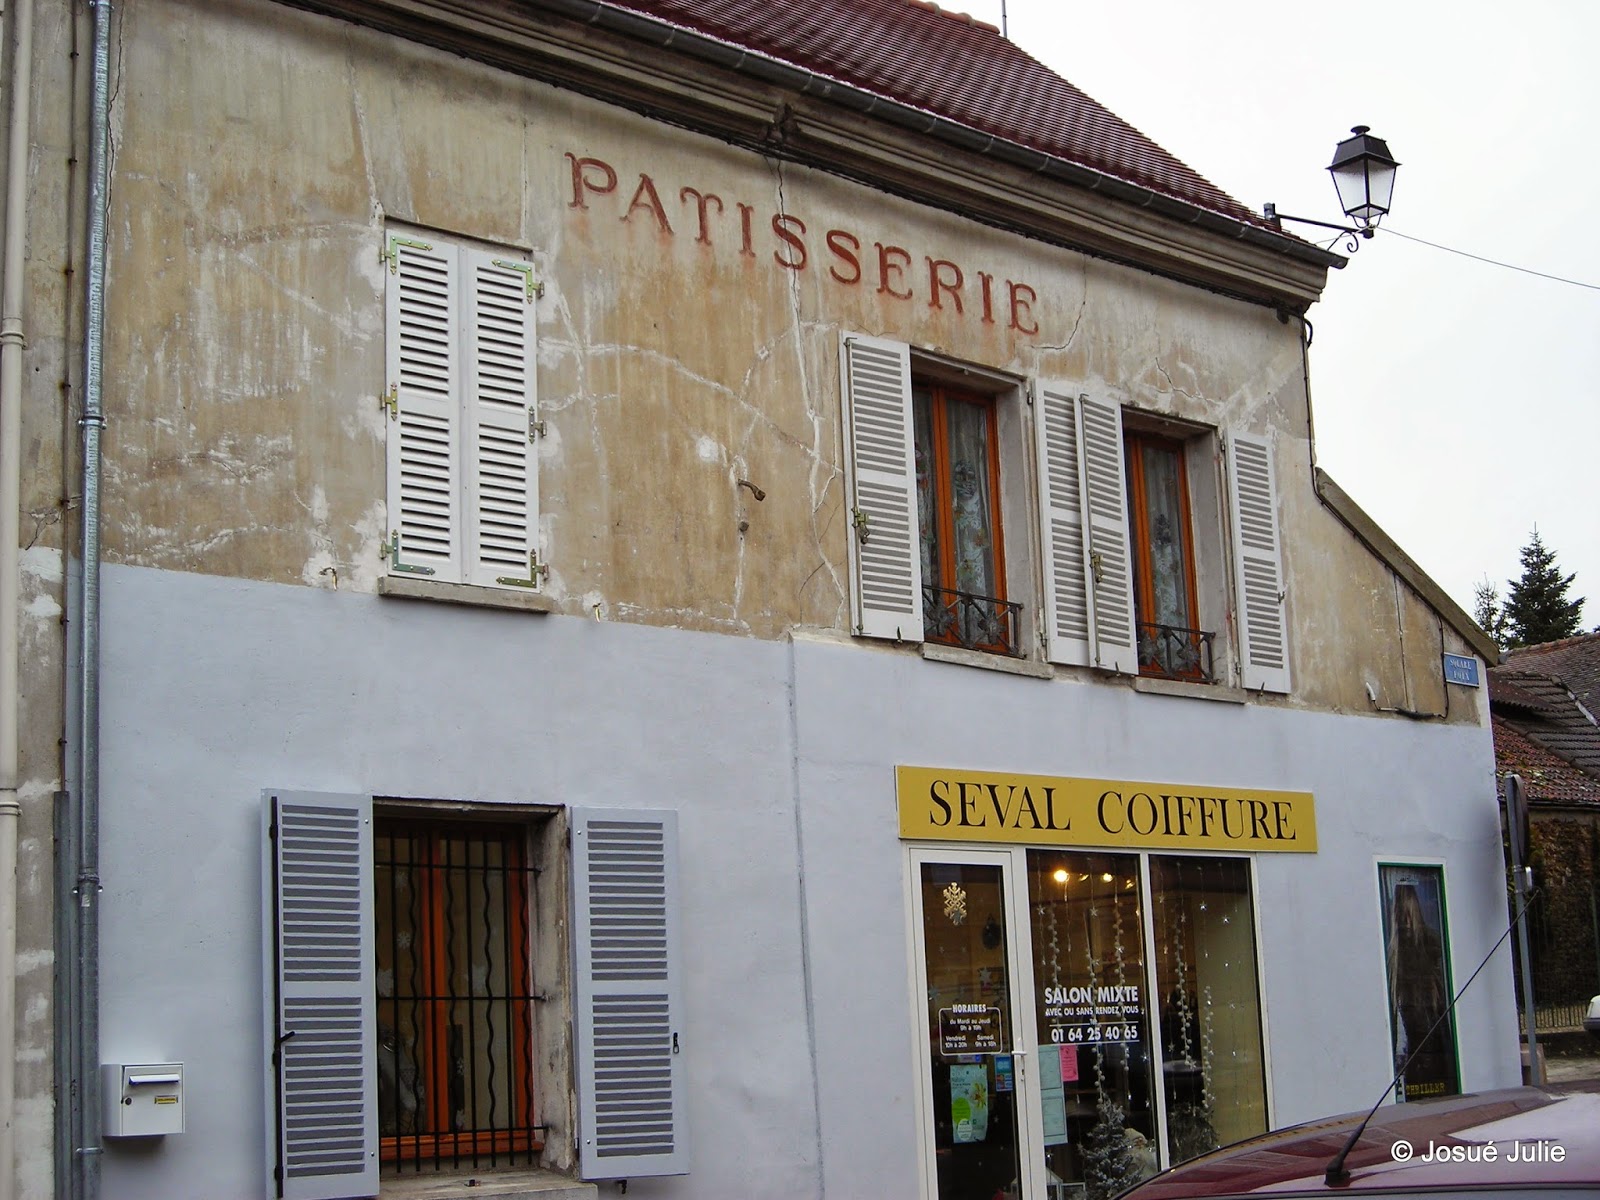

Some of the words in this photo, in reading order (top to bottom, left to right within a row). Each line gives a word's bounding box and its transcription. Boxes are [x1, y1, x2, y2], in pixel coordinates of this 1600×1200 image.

[564, 152, 1040, 336] PATISSERIE
[929, 779, 1071, 831] SEVAL
[1098, 790, 1297, 840] COIFFURE
[1044, 986, 1092, 1004] SALON
[1098, 985, 1139, 1003] MIXTE
[952, 1003, 987, 1013] HORAIRES
[1045, 1007, 1062, 1017] AVEC
[1064, 1008, 1074, 1016] OU
[1076, 1007, 1093, 1015] SANS
[1095, 1006, 1119, 1015] RENDEZ
[1122, 1005, 1139, 1014] VOUS
[1051, 1028, 1064, 1042] 01
[1068, 1028, 1083, 1041] 64
[1087, 1026, 1101, 1041] 25
[1105, 1026, 1120, 1040] 40
[1124, 1025, 1138, 1039] 65
